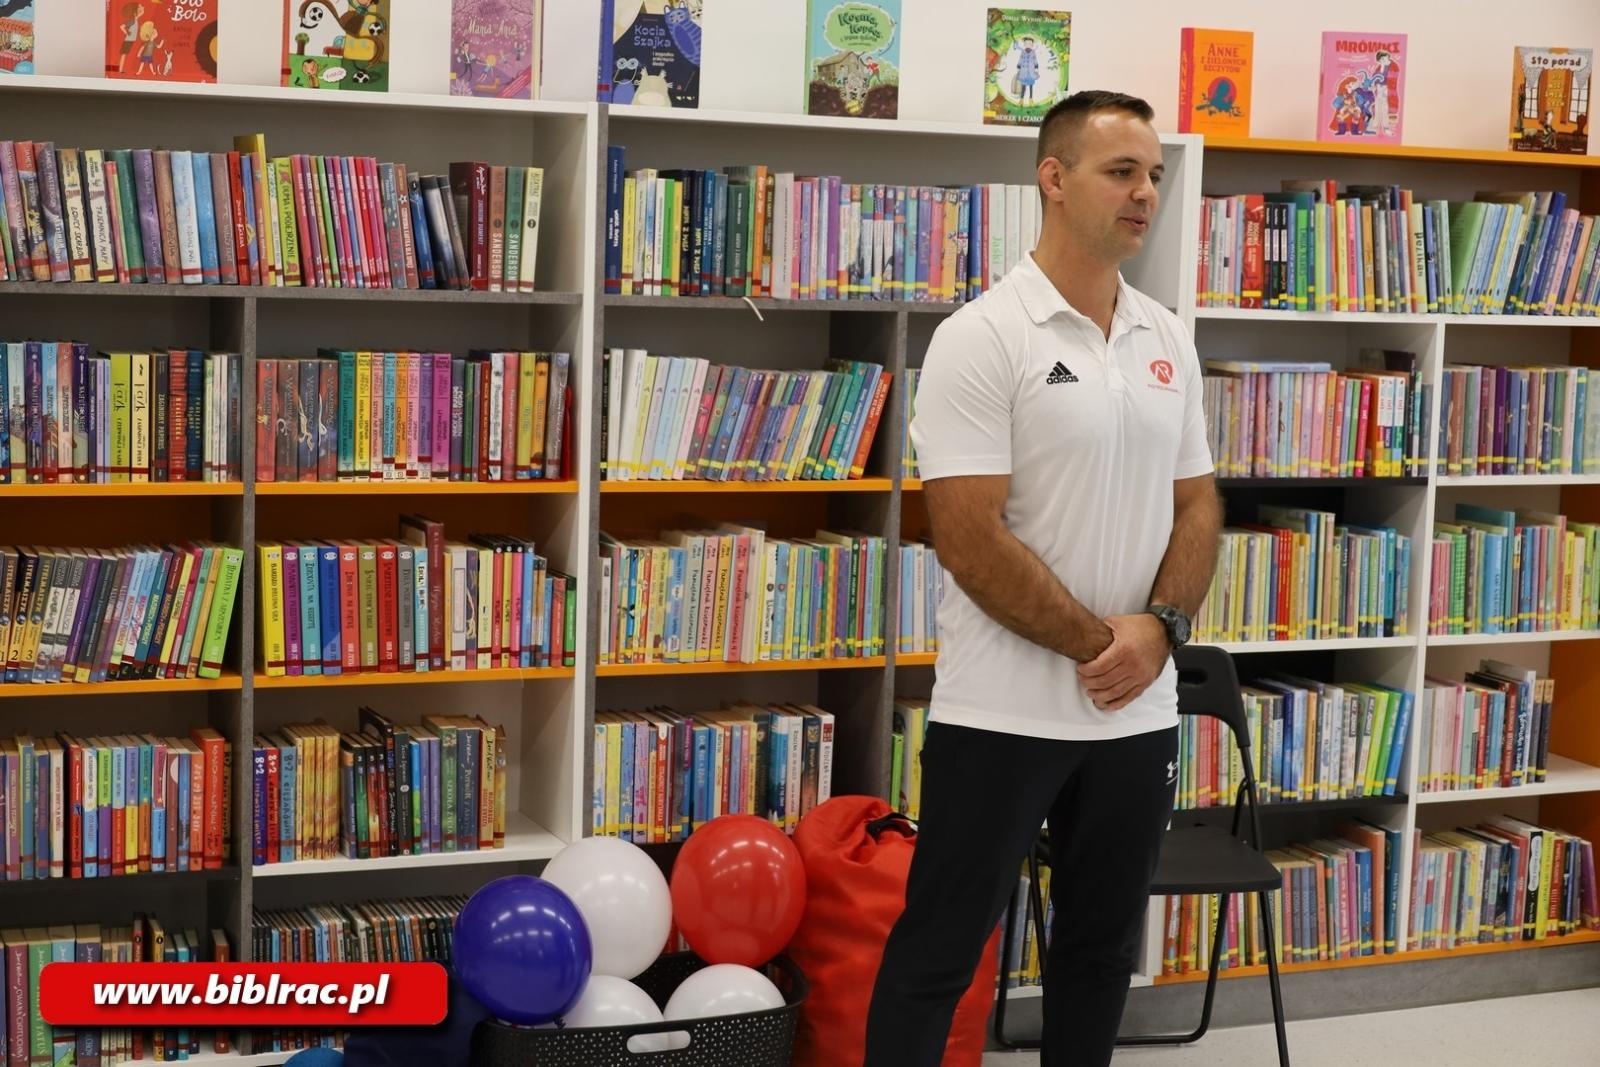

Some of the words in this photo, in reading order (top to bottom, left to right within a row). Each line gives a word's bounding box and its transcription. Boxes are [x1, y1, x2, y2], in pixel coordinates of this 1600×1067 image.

[634, 25, 666, 36] Kocia
[634, 36, 672, 50] Szajka
[1208, 42, 1240, 58] ANNE
[1551, 58, 1582, 67] porad
[96, 206, 107, 243] TAJEMNICA
[284, 211, 295, 258] PODEJRZENIE
[99, 245, 109, 265] MAPY
[1047, 374, 1079, 385] adidas
[19, 564, 34, 612] STELMASZYK
[690, 569, 699, 602] Pamiętnik
[704, 569, 713, 602] Pamiętnik
[718, 569, 728, 602] Pamiętnik
[735, 569, 744, 602] Pamiętnik
[11, 650, 19, 660] 2
[25, 650, 33, 660] 3
[268, 754, 277, 774] 8+2
[446, 779, 454, 810] SZKOŁA
[446, 811, 455, 834] ŻYCIA
[15, 1016, 24, 1058] CIOTUCHNA
